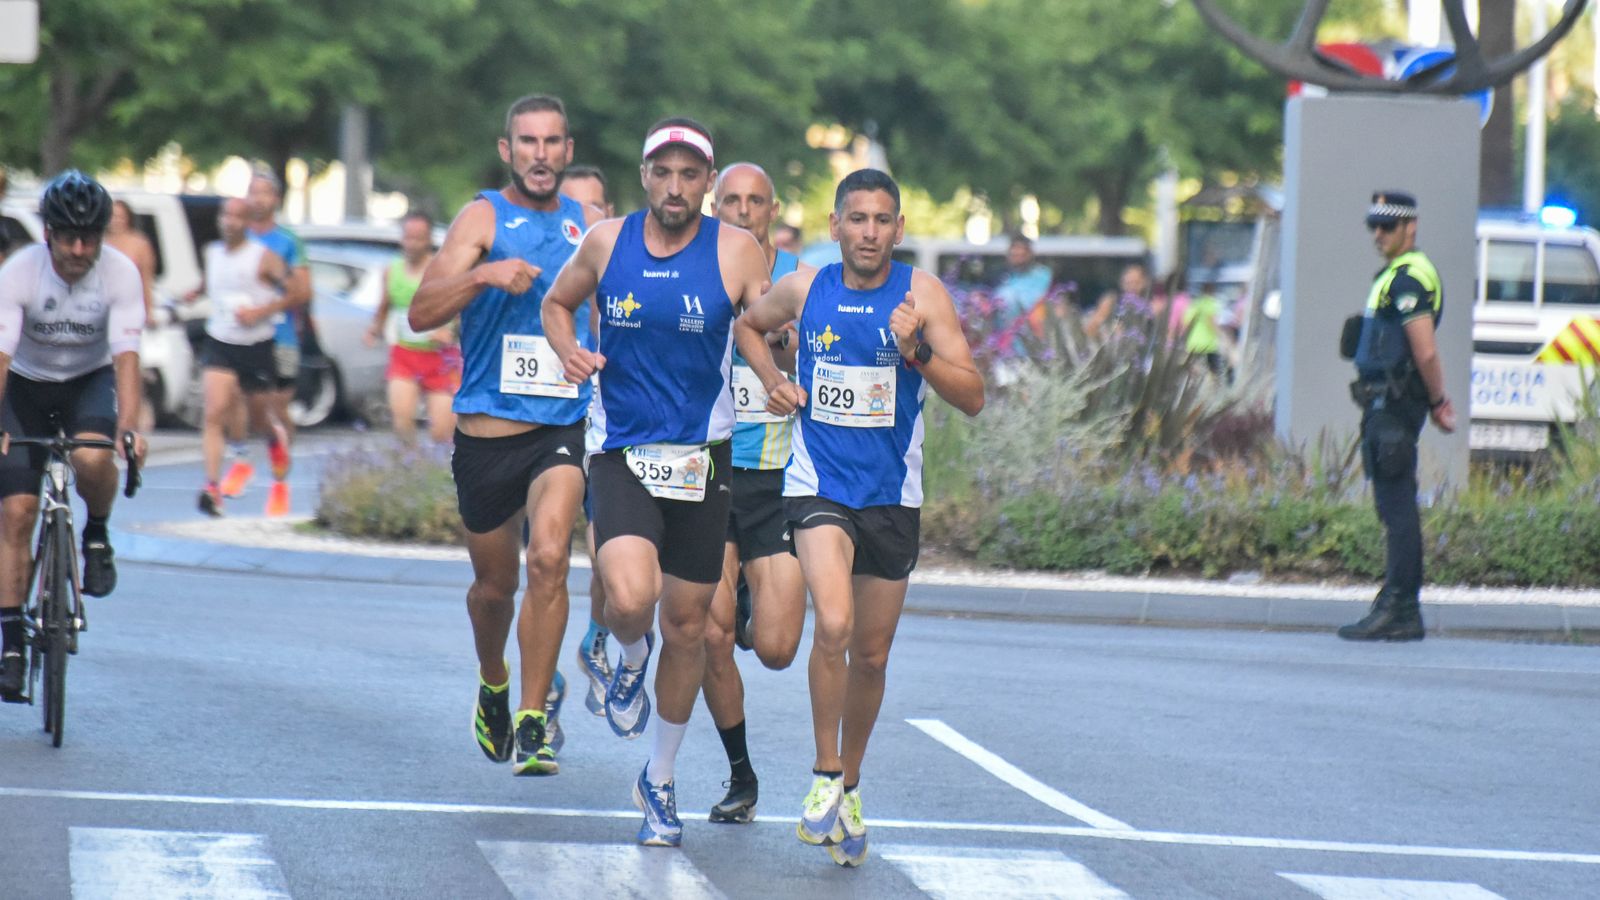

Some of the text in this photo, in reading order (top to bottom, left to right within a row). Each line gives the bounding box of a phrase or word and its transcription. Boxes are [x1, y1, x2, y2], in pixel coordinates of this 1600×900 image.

[643, 269, 670, 278] luanvi
[838, 304, 864, 314] luanvi
[515, 357, 538, 378] 39
[816, 367, 830, 377] XXI
[818, 385, 855, 409] 629
[635, 461, 673, 481] 359
